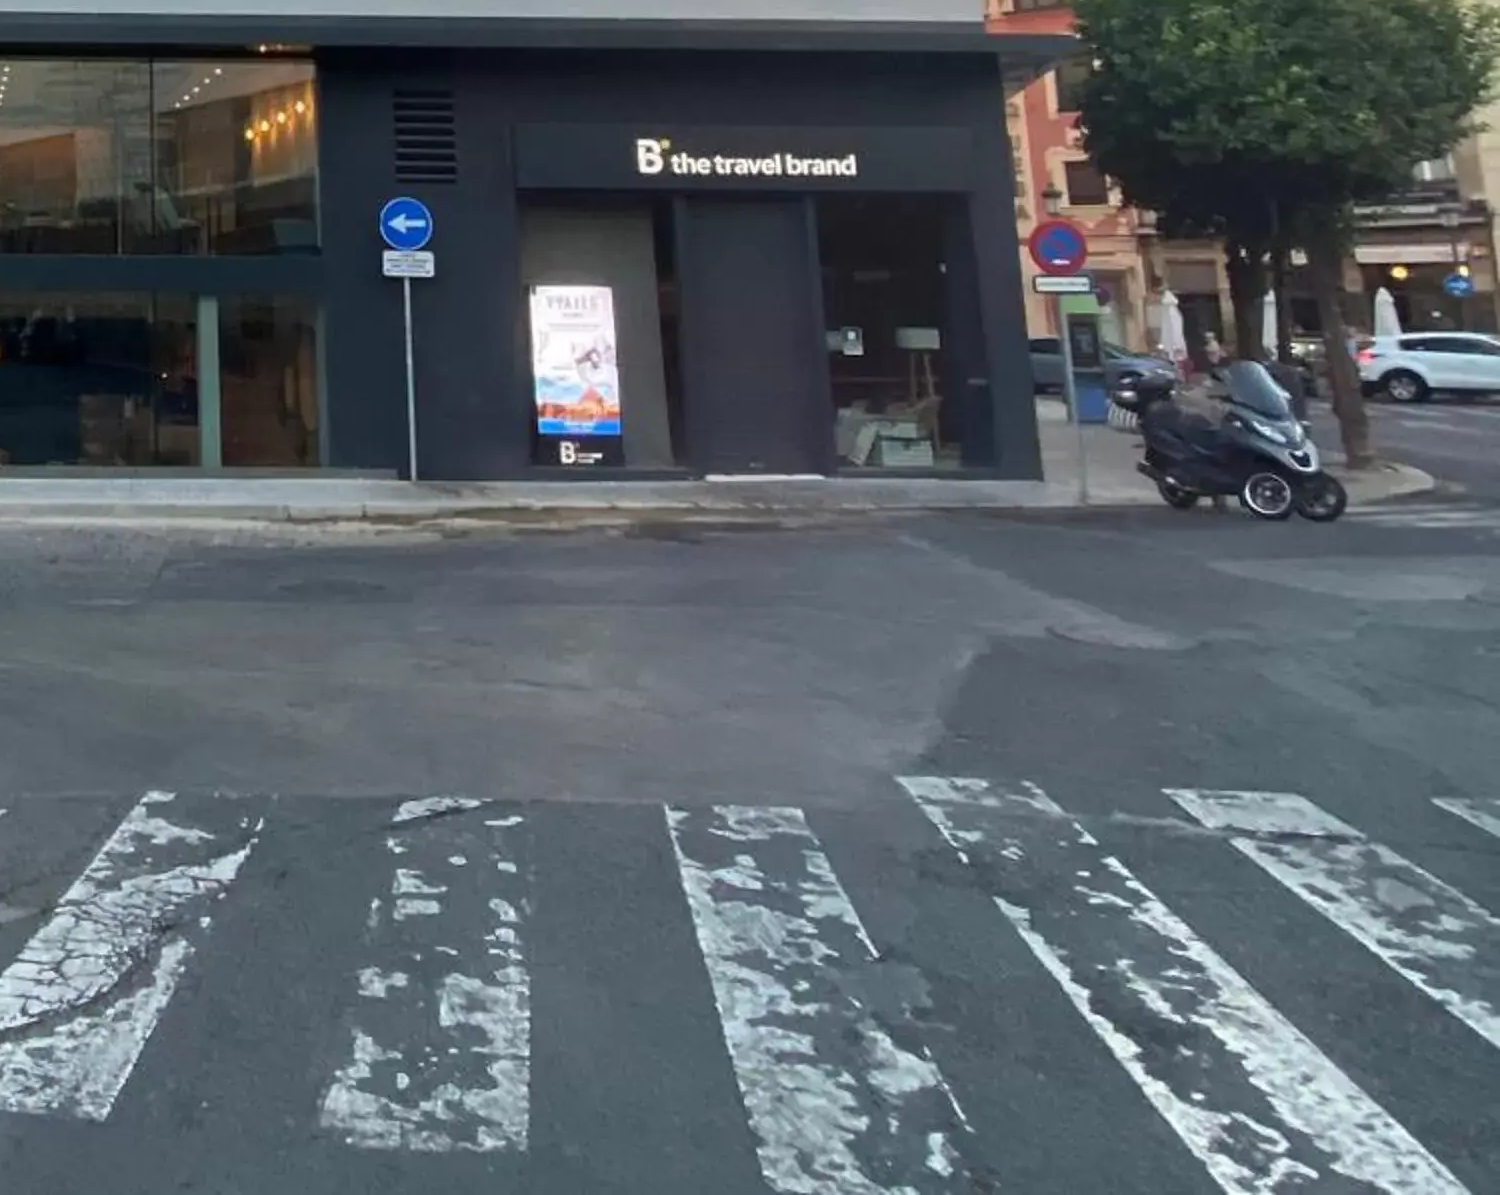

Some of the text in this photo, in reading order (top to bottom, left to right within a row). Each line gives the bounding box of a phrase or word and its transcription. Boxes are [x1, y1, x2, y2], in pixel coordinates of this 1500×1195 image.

[670, 153, 710, 175] the
[714, 153, 782, 176] travel
[785, 153, 857, 176] brand
